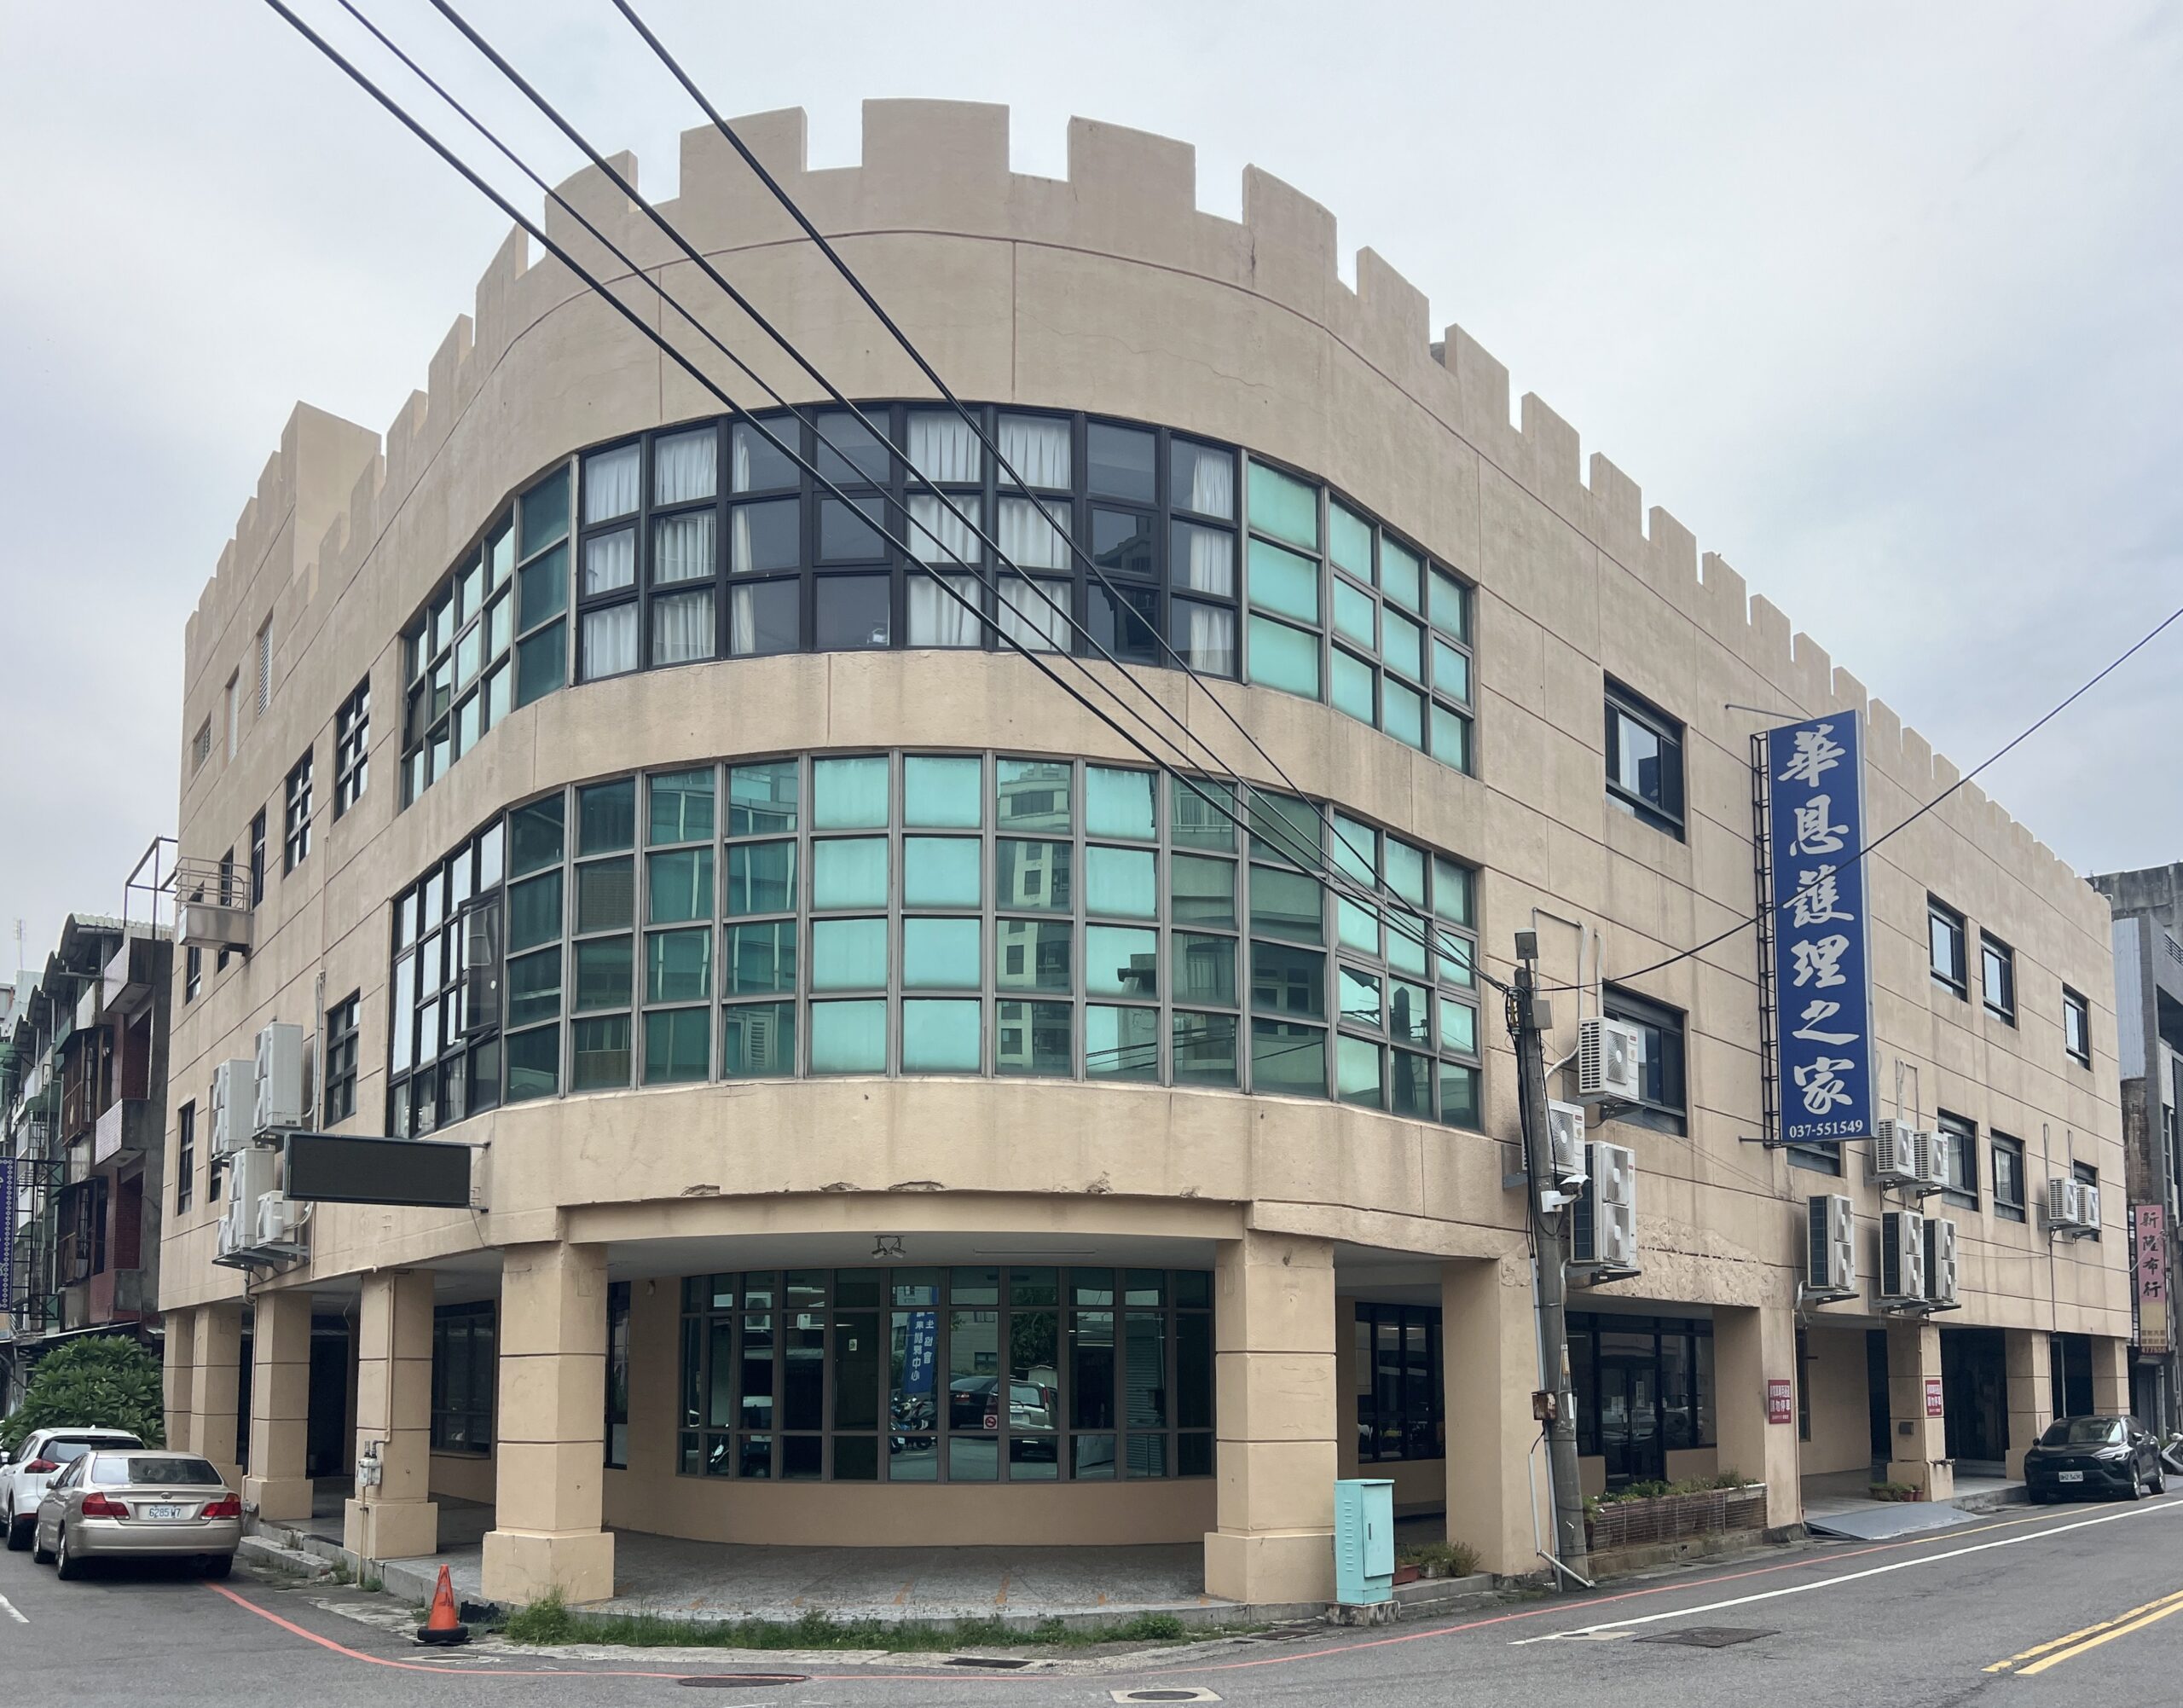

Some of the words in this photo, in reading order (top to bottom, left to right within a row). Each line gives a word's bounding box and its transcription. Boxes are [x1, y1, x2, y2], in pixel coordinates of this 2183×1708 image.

[1778, 723, 1860, 1115] 華恩護理之家
[1789, 1119, 1864, 1139] 037-551549
